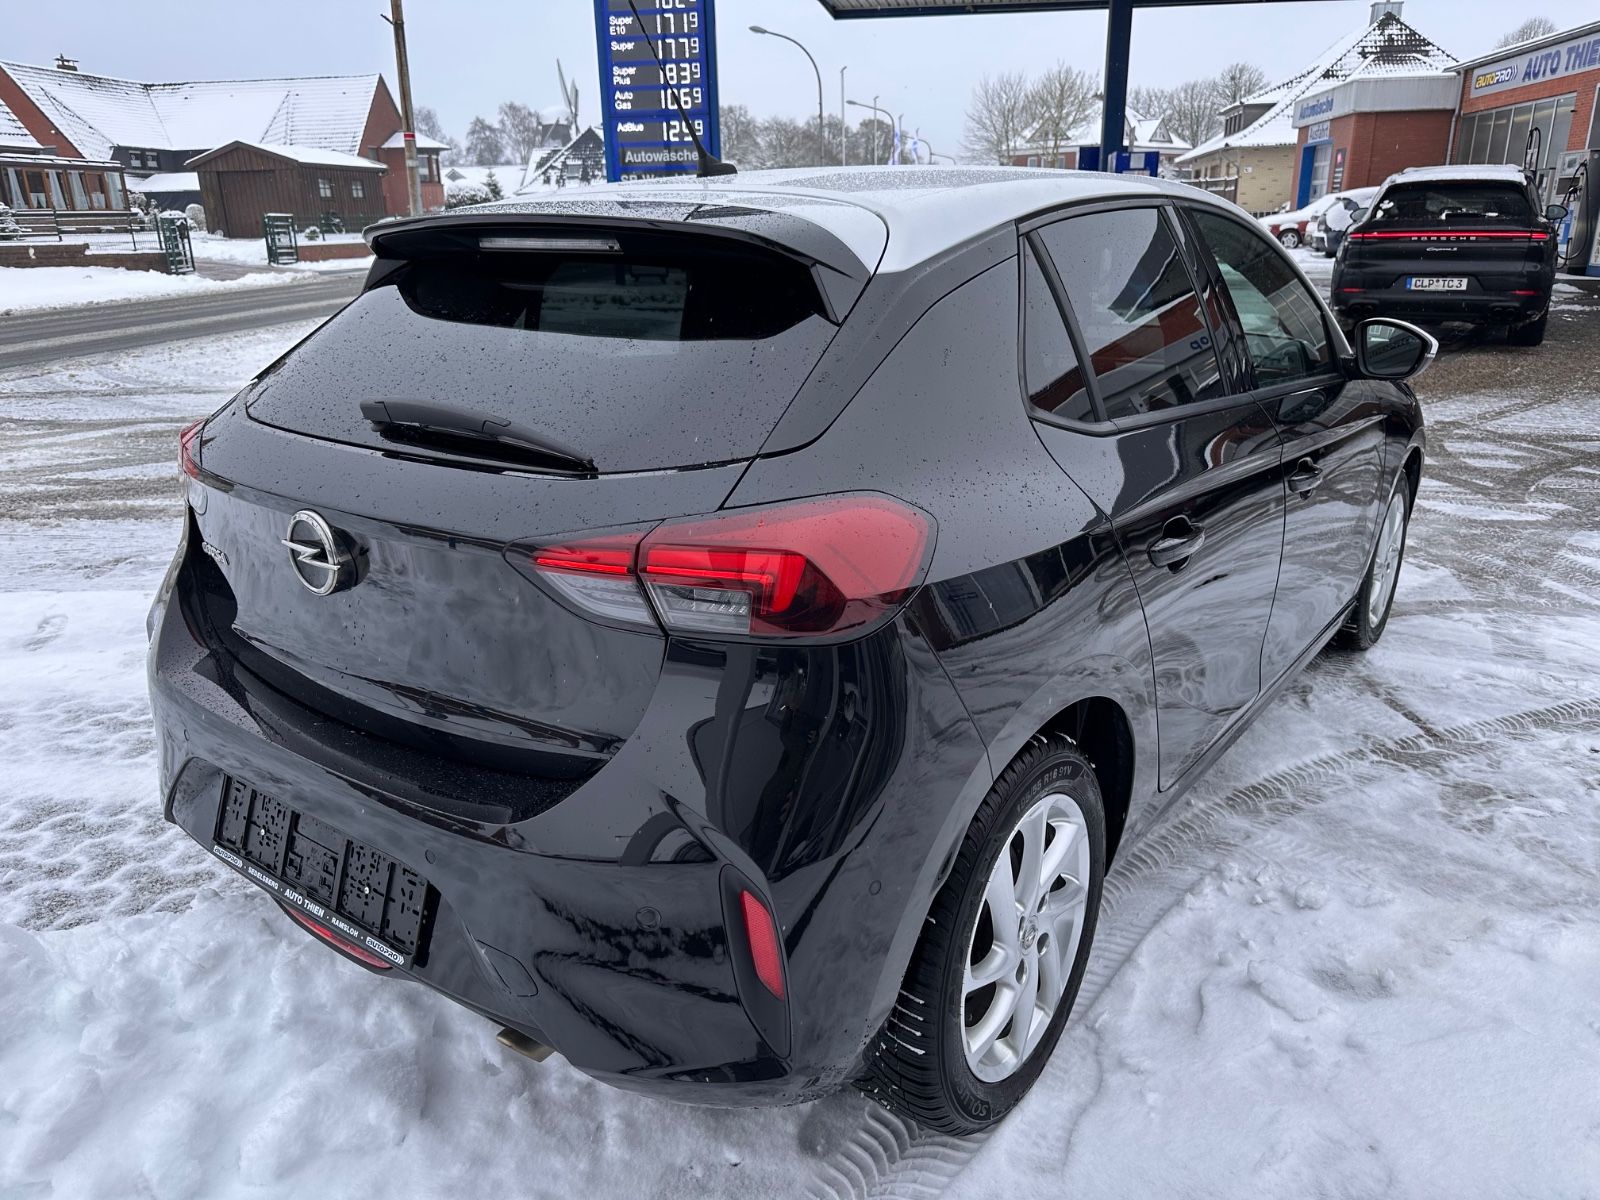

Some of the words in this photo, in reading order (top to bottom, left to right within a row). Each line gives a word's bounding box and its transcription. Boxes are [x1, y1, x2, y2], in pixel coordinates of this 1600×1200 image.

[609, 16, 633, 26] Super
[610, 26, 626, 35] E10
[611, 41, 635, 52] Super
[1521, 49, 1562, 83] AUTO
[1564, 37, 1600, 72] THIE
[613, 66, 636, 76] Super
[613, 76, 631, 86] Plus
[615, 91, 633, 100] Auto
[615, 101, 632, 110] Gas
[617, 121, 644, 132] AdBlue
[625, 149, 699, 163] Autowäsche
[1456, 279, 1463, 288] 3
[284, 889, 303, 905] AUTO
[304, 900, 325, 918] THIEN
